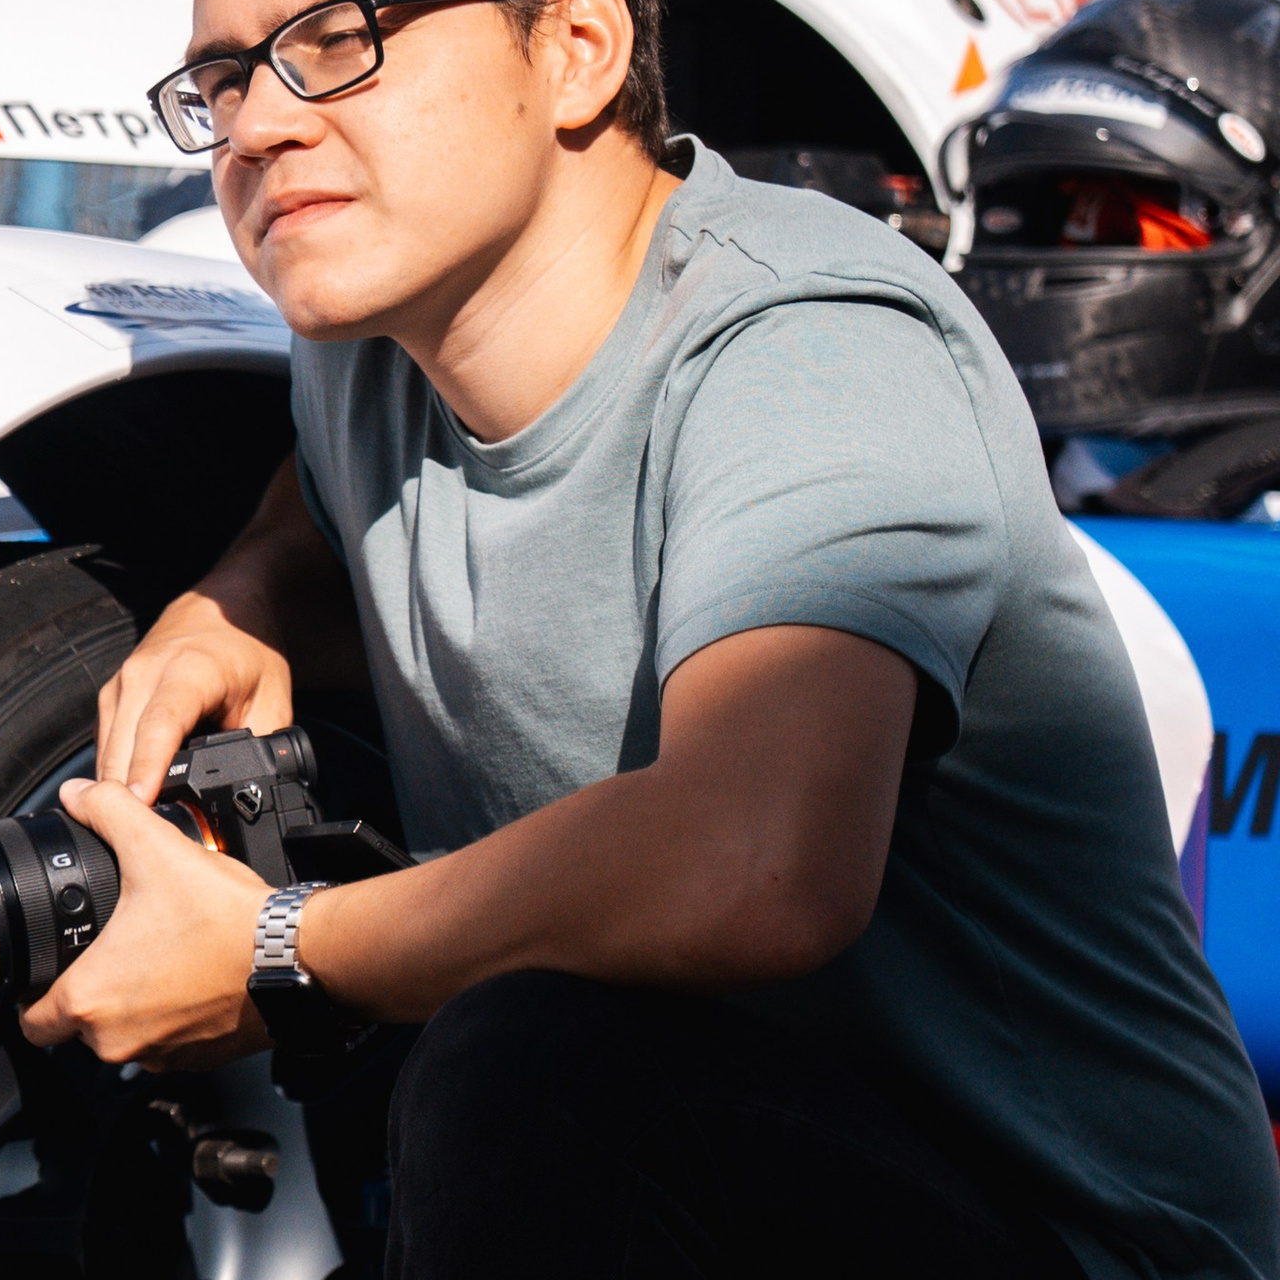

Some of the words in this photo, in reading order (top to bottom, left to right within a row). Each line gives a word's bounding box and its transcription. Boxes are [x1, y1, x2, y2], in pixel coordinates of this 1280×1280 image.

[0, 100, 169, 149] Петр
[168, 763, 189, 777] SONY
[52, 853, 72, 868] G
[63, 927, 73, 937] AF
[81, 923, 92, 933] MF
